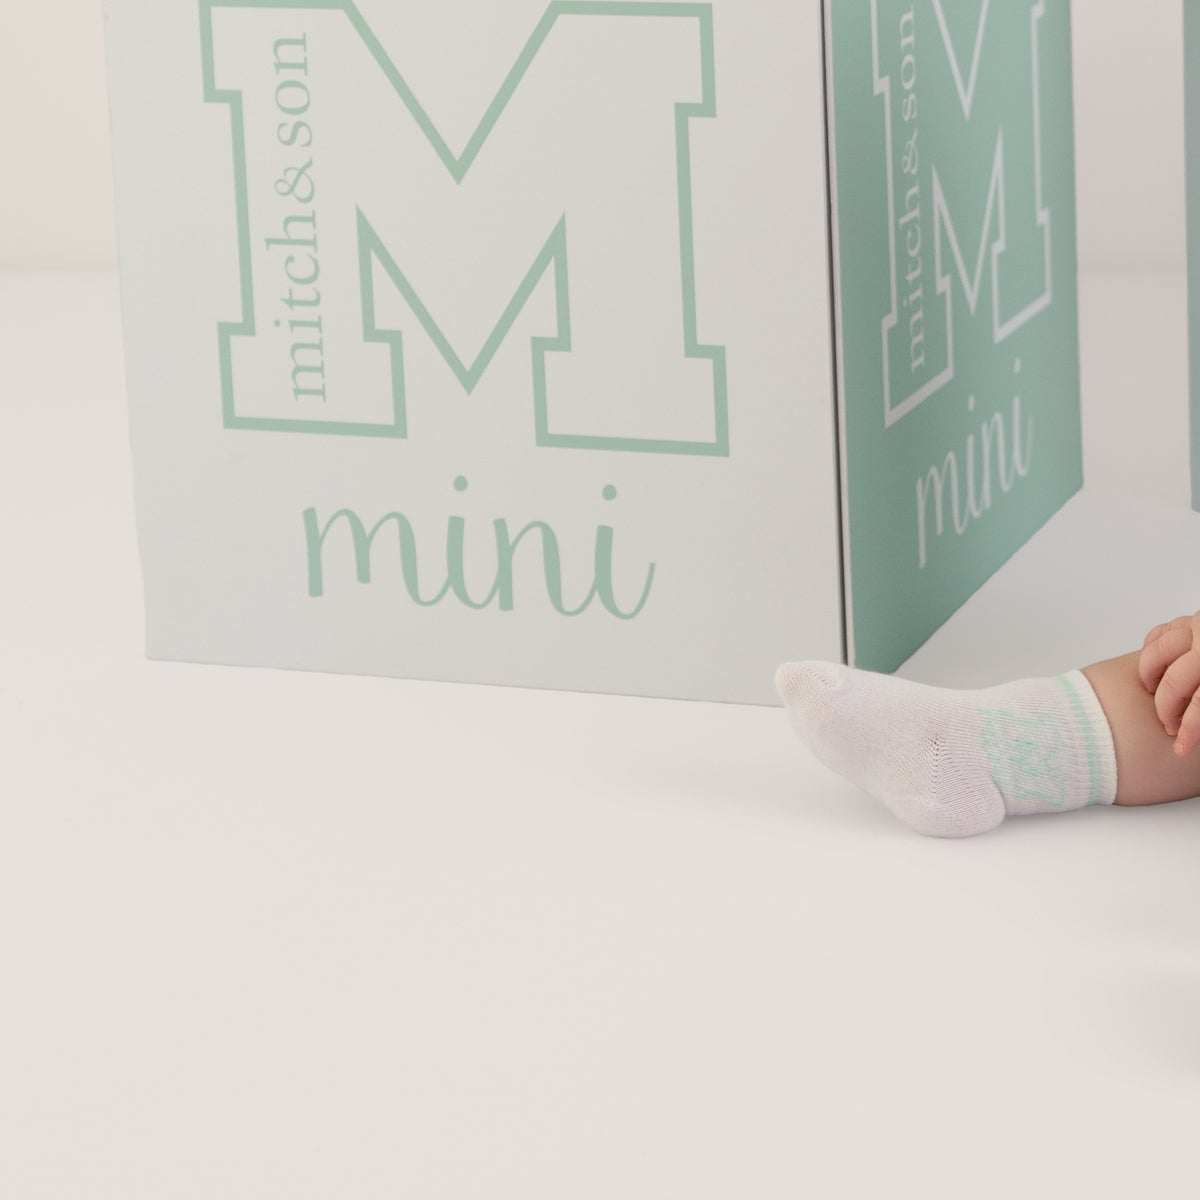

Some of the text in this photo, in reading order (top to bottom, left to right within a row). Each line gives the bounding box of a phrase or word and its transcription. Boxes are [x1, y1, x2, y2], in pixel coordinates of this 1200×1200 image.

[264, 31, 326, 403] mitch&son
[897, 6, 925, 374] mitch&son
[302, 474, 656, 622] mini
[915, 356, 1035, 570] mini
